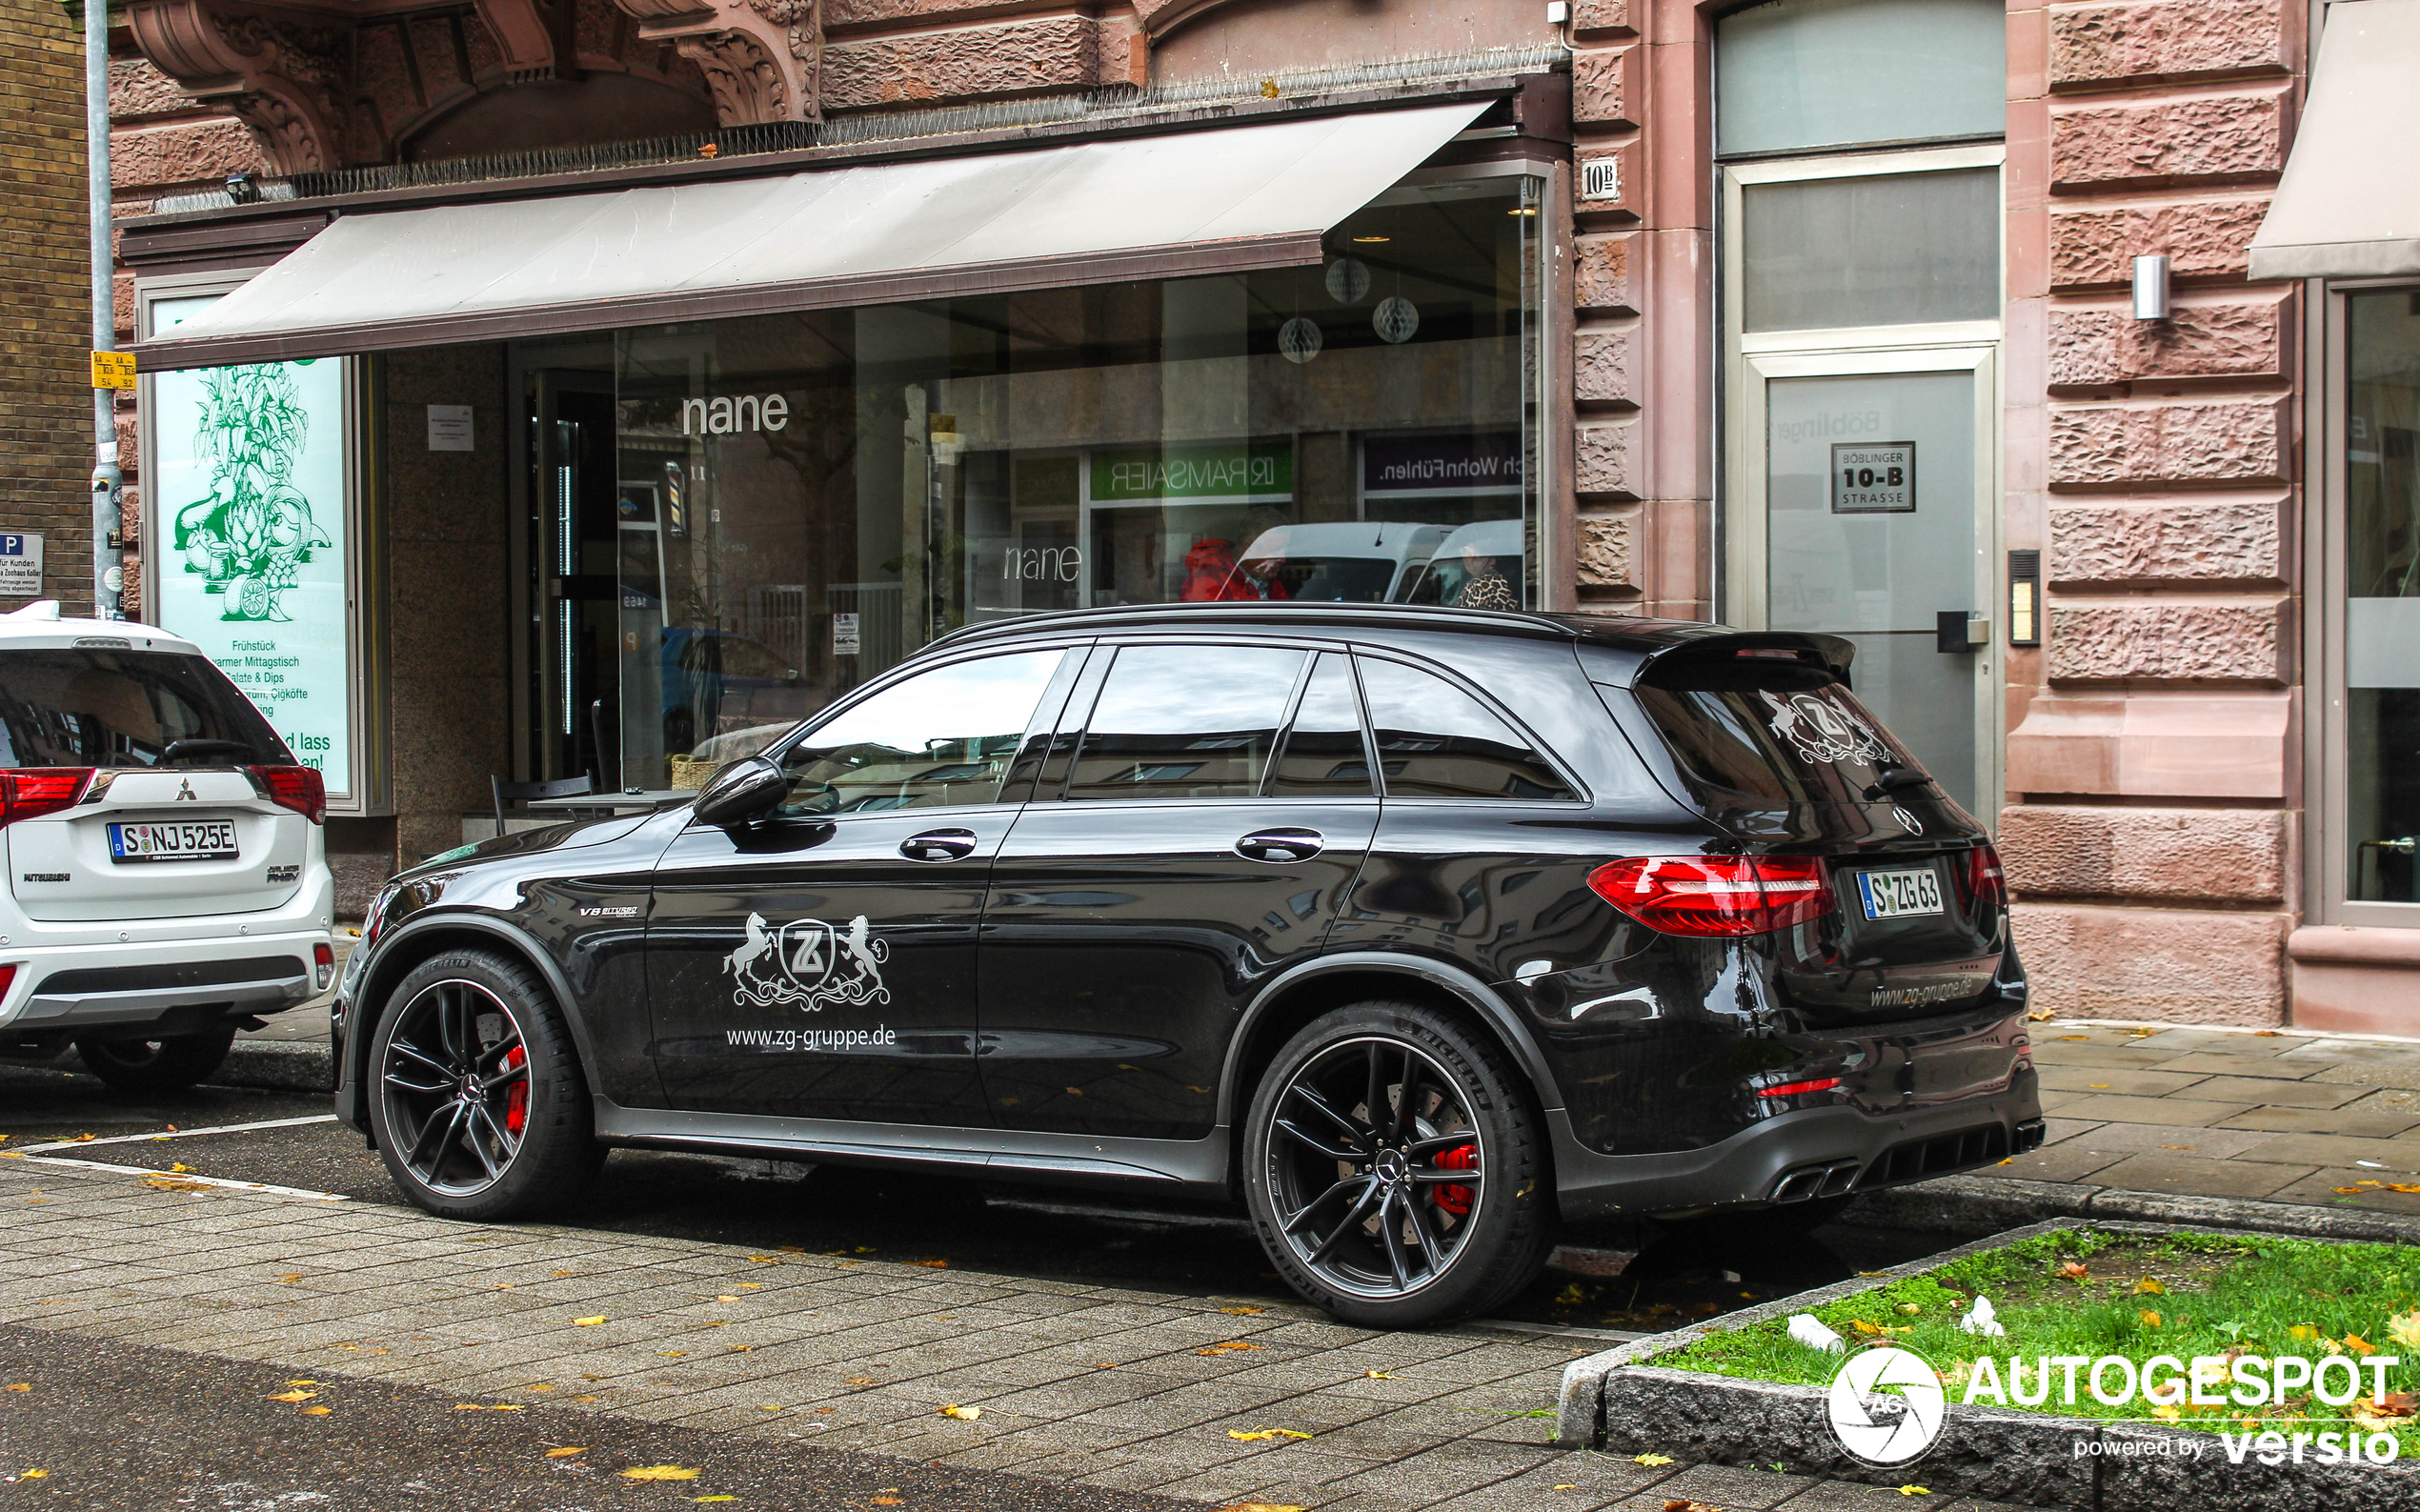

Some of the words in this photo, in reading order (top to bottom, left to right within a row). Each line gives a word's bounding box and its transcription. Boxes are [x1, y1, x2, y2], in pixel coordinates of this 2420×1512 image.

[1583, 165, 1613, 194] 10B
[683, 393, 788, 434] nane
[1843, 453, 1903, 464] BÖBLINGER
[1844, 467, 1904, 488] 10-B
[1843, 493, 1903, 503] STRASSE
[7, 536, 17, 554] P
[10, 558, 35, 567] Kunden
[1003, 546, 1082, 582] nane
[232, 640, 276, 651] Frühstück
[245, 656, 299, 669] Mittagstisch
[255, 672, 261, 683] &
[264, 672, 285, 685] Dips
[300, 733, 331, 750] lass
[124, 827, 139, 852] S
[151, 826, 180, 851] NJ
[182, 824, 235, 850] 525E
[24, 873, 71, 882] MITSUBISHI
[1866, 900, 1872, 910] D
[1872, 877, 1886, 912] S
[1892, 876, 1919, 910] ZG
[1918, 874, 1939, 908] 63
[580, 907, 602, 917] V8
[1871, 974, 1973, 1009] www.zg-gruppe.de
[726, 1024, 896, 1051] www.zg-gruppe.de
[1417, 1028, 1490, 1105] MICHELIN
